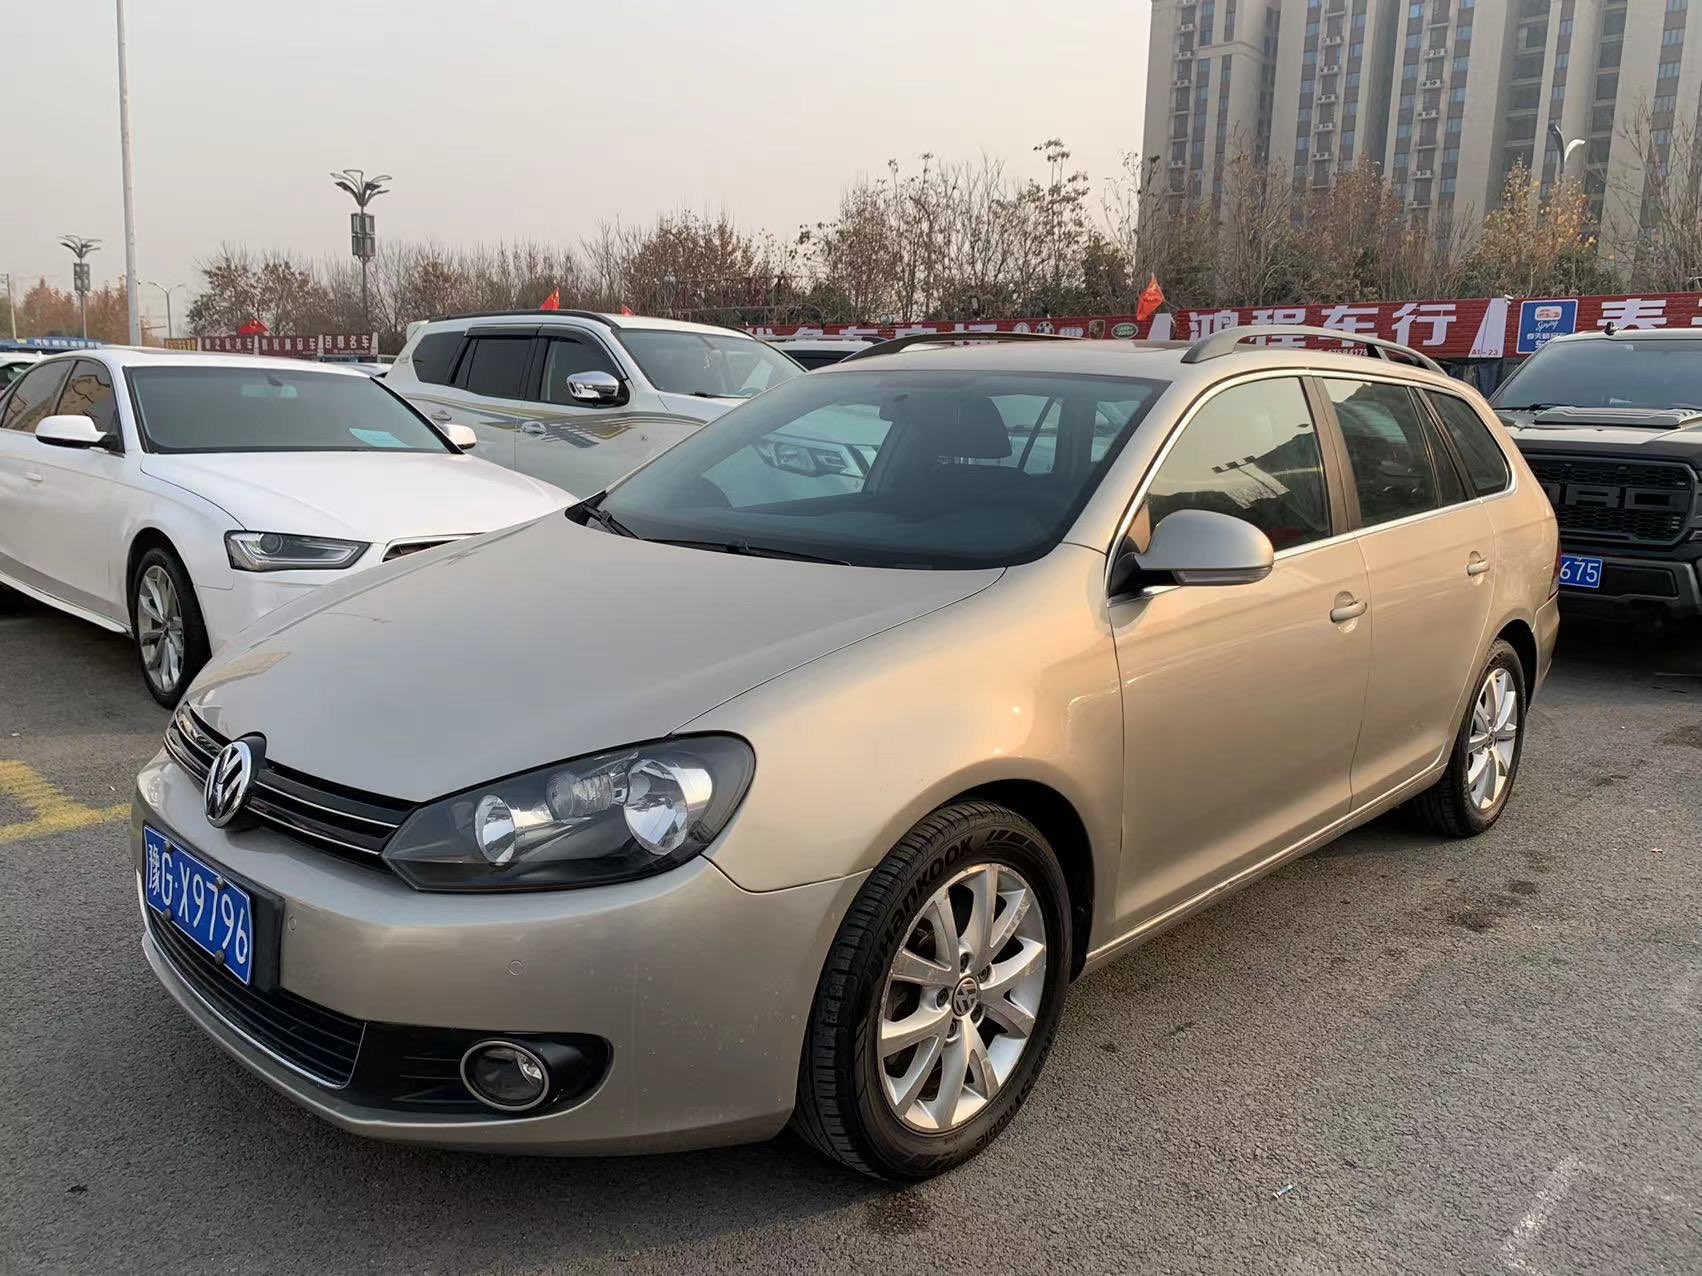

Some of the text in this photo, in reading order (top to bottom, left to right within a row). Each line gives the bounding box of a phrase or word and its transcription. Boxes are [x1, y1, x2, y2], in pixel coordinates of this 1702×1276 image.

[1188, 303, 1456, 347] 鸿程车行
[1560, 561, 1598, 583] 675
